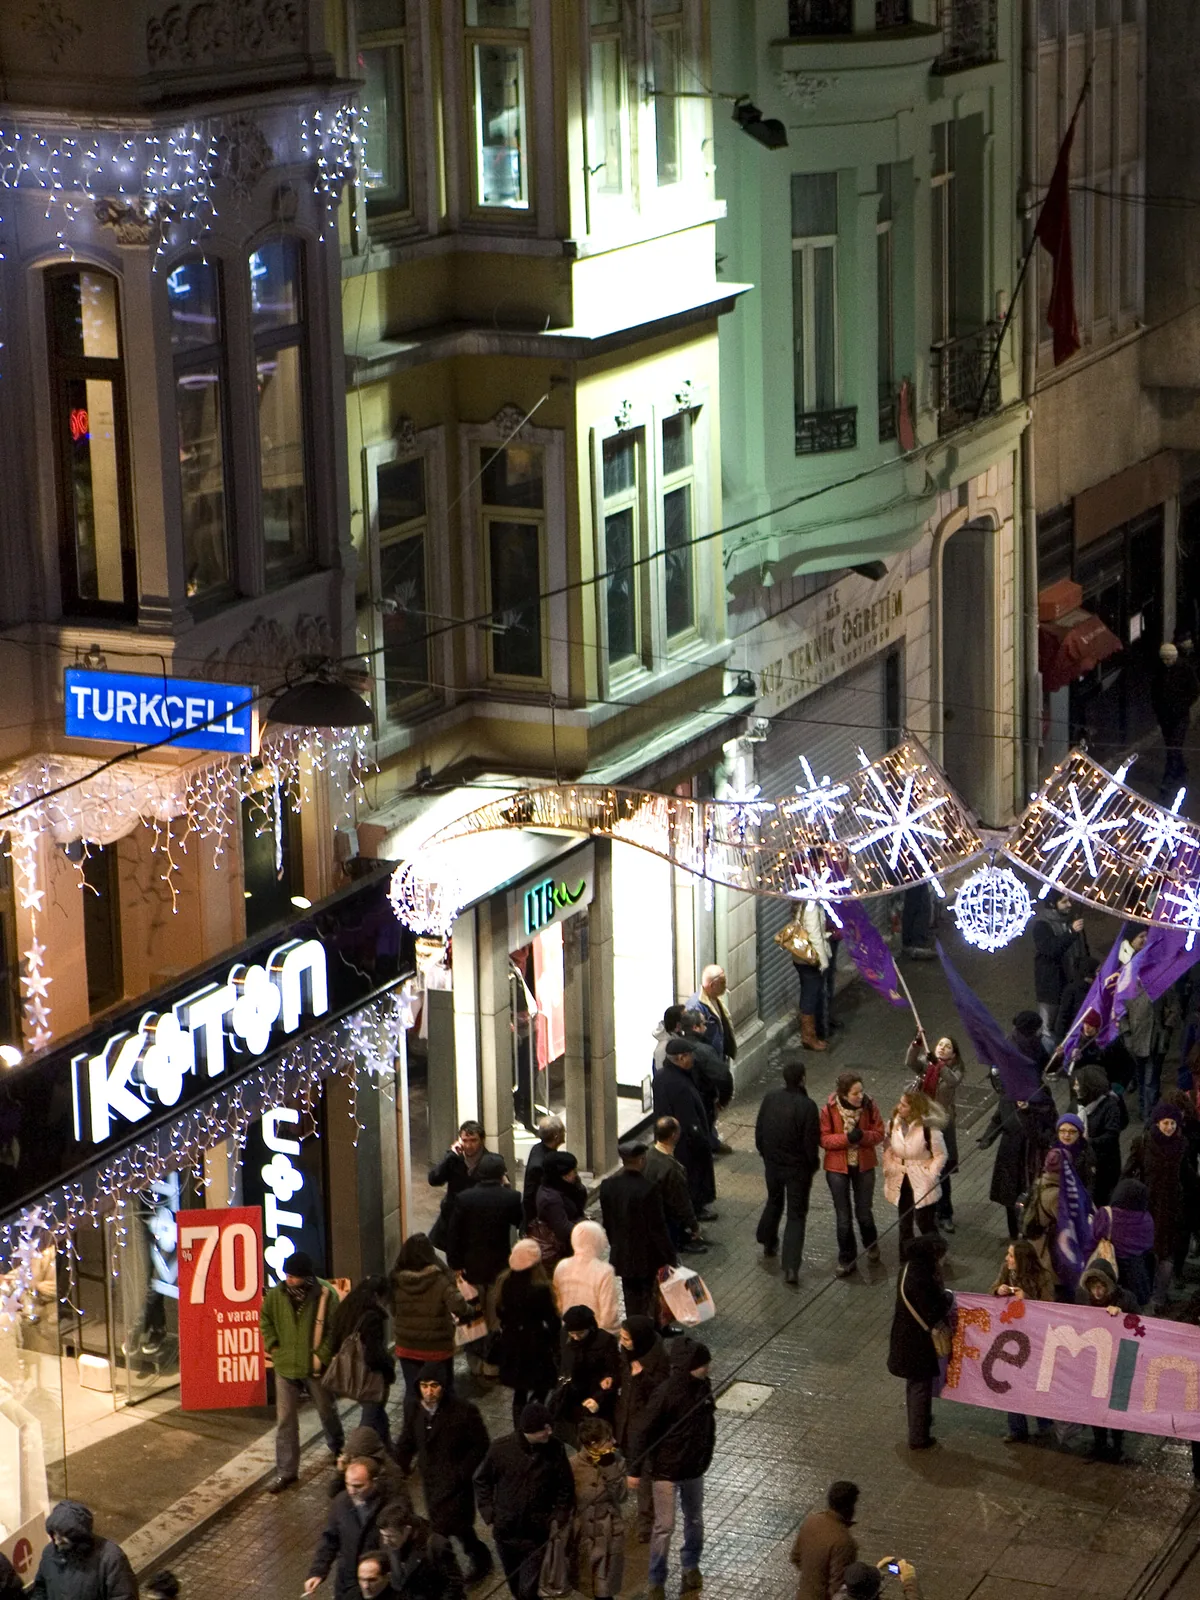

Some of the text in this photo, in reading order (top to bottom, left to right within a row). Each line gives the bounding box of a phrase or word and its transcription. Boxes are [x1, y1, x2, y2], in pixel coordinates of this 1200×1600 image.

[761, 658, 783, 697] KIZ
[788, 624, 835, 678] TEKNİK
[842, 590, 903, 646] ÖĞRETİM
[71, 685, 245, 736] TURKCELL
[524, 877, 556, 936] LTB
[227, 1309, 259, 1323] varan
